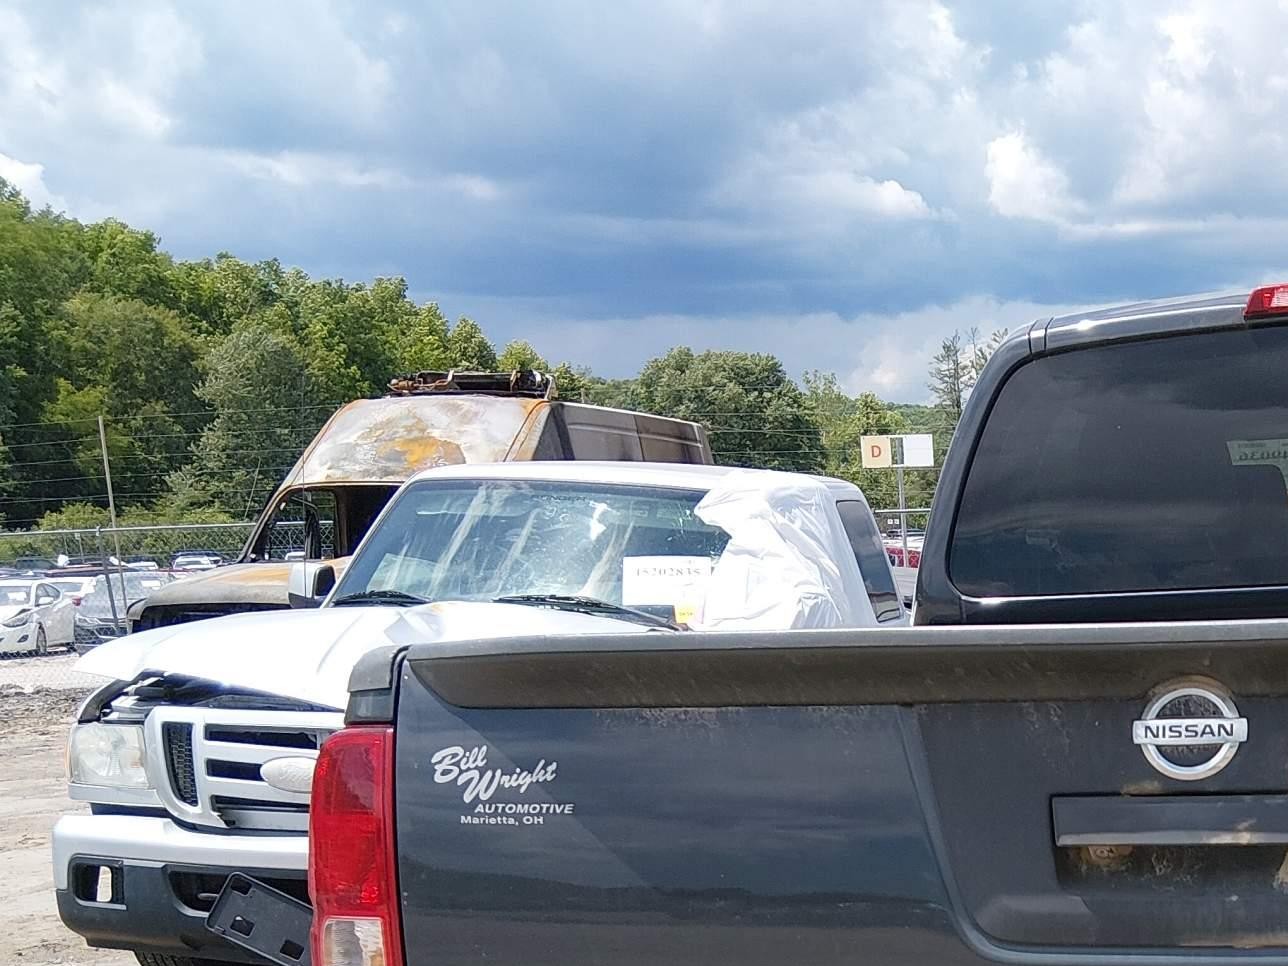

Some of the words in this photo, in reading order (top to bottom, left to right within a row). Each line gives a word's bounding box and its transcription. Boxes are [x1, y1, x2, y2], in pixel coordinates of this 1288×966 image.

[871, 445, 882, 458] D
[1144, 723, 1234, 739] NISSAN
[431, 745, 487, 784] Bill
[457, 759, 557, 803] Wright
[474, 803, 575, 814] AUTOMOTIVE
[460, 815, 519, 826] Marietta,
[523, 815, 544, 825] OH
